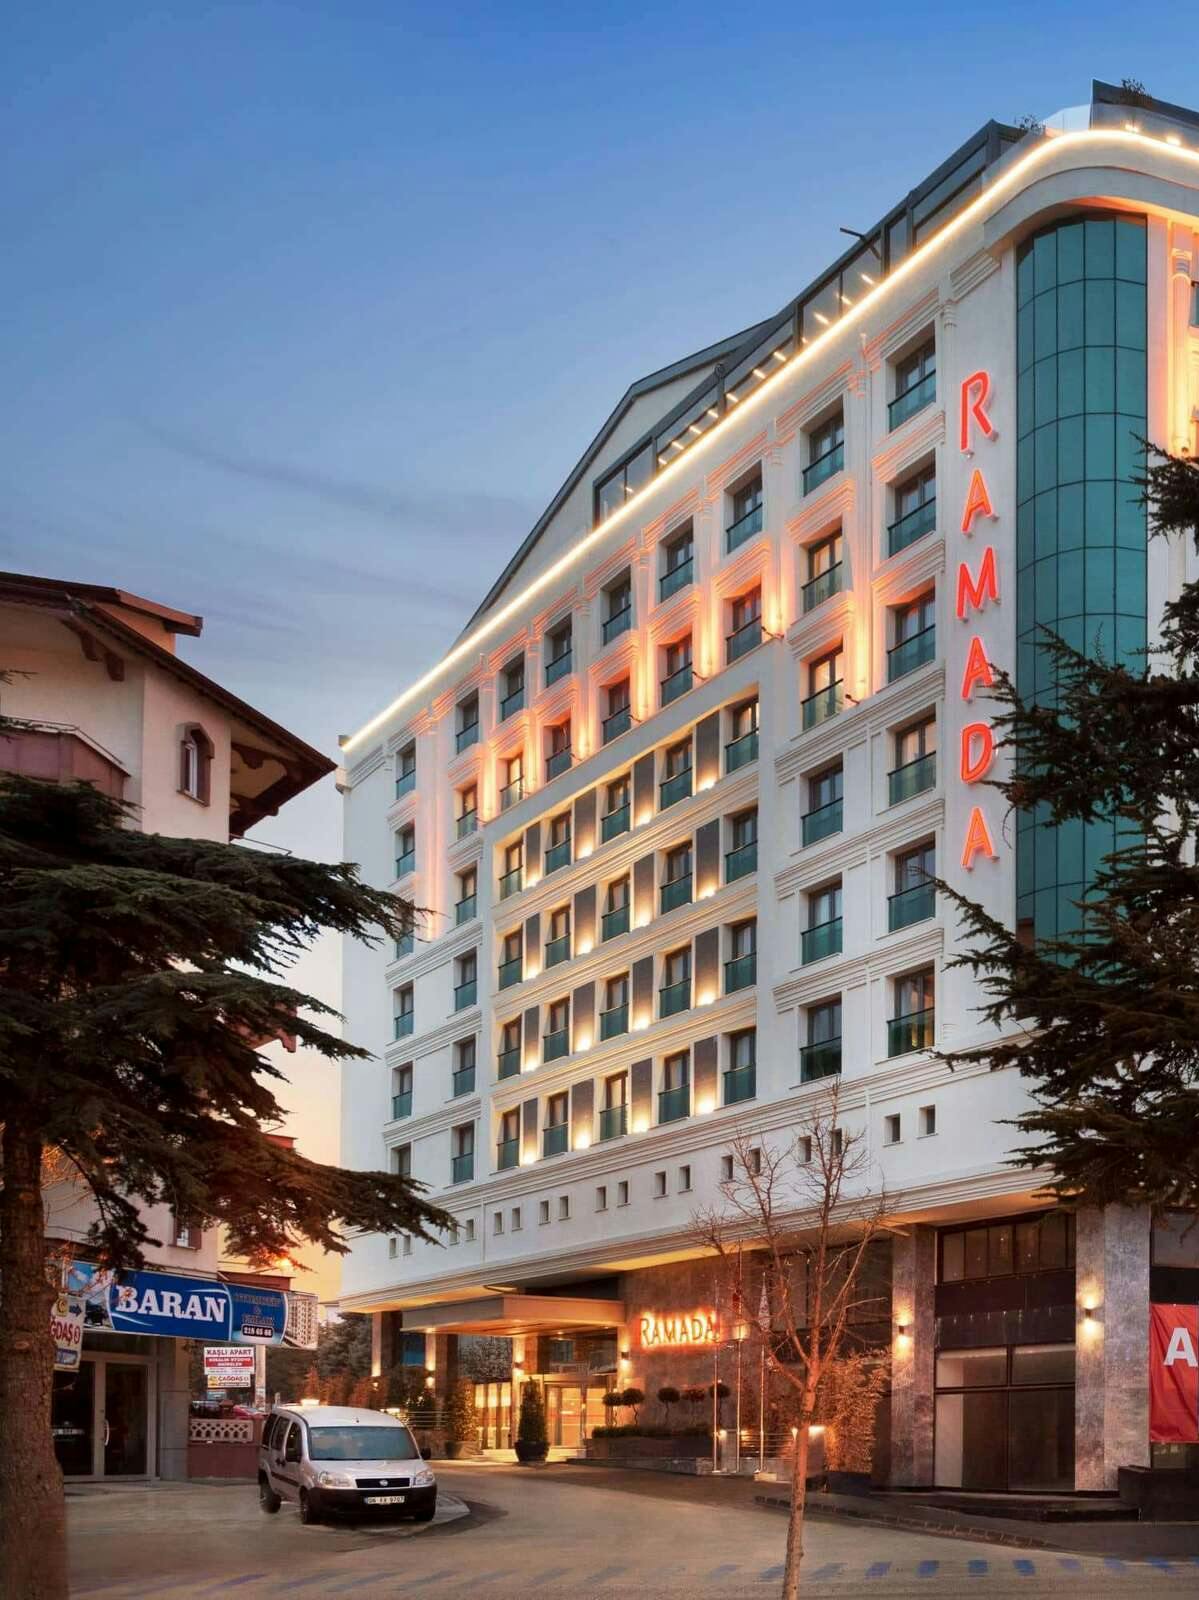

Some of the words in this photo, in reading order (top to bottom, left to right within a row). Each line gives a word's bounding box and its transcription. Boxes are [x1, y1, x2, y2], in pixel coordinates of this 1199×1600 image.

[957, 369, 998, 872] RAMADA
[115, 1284, 226, 1323] BARAN
[640, 1316, 718, 1346] RAMADA
[1164, 1327, 1199, 1367] A
